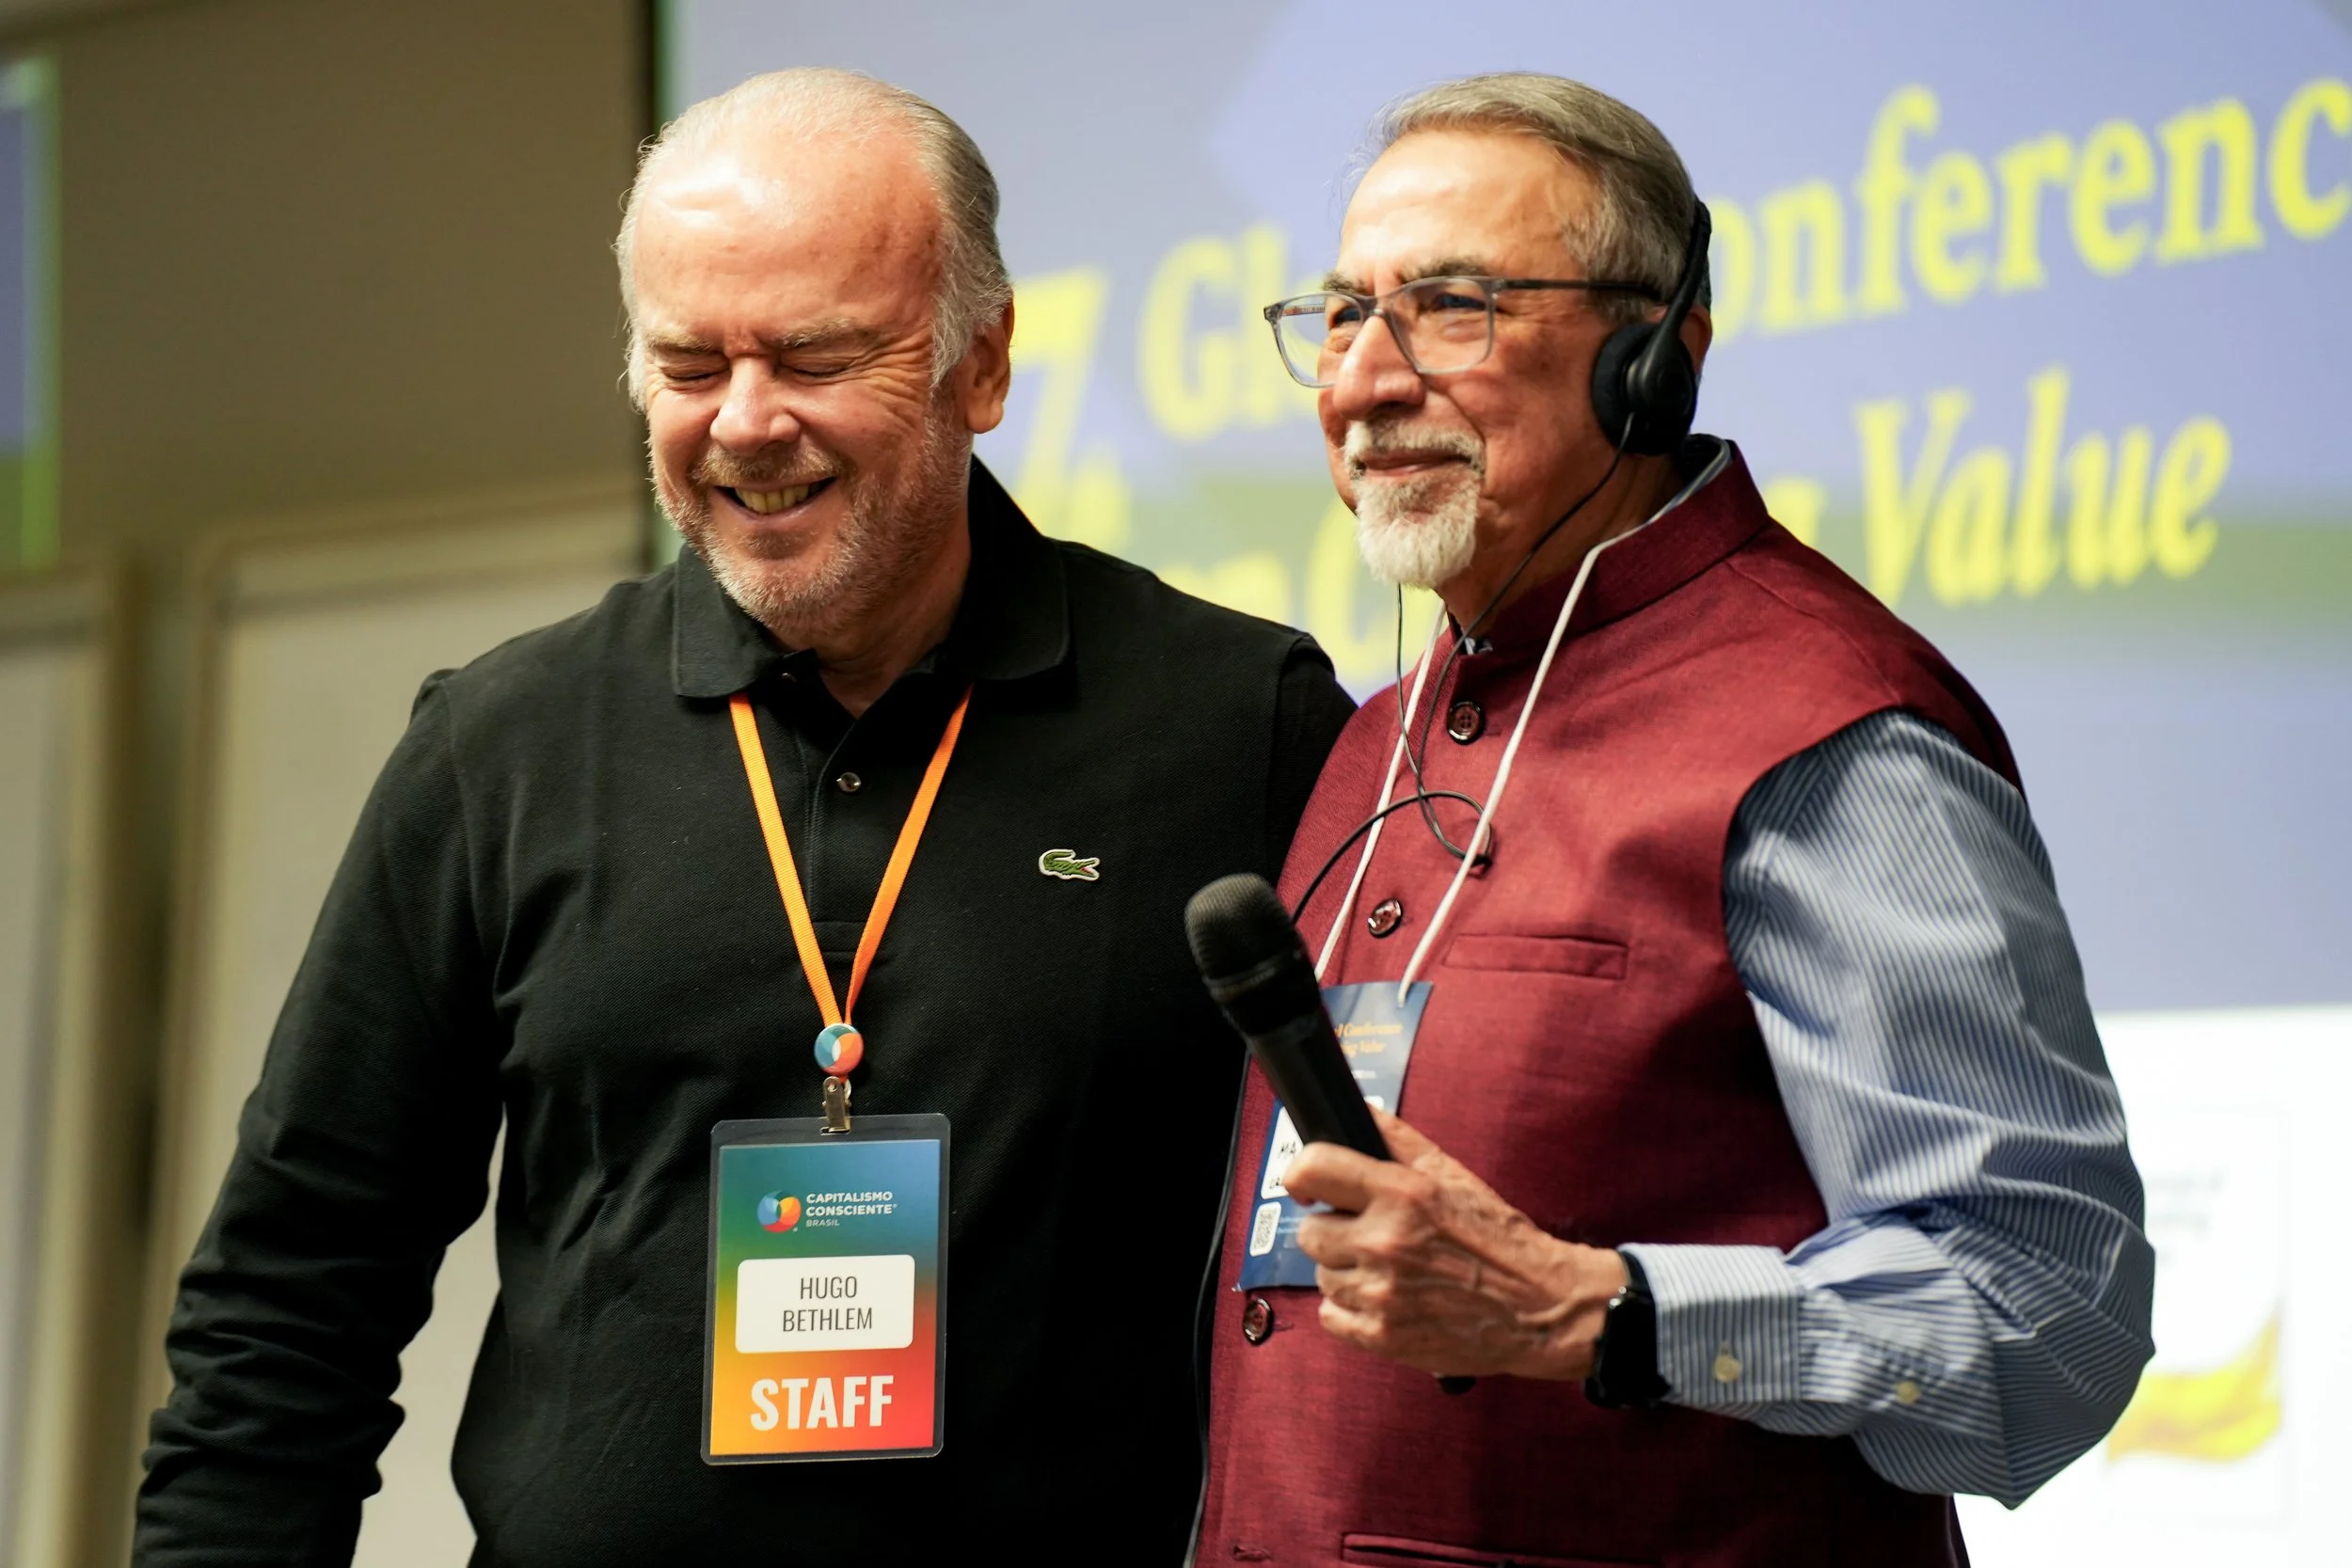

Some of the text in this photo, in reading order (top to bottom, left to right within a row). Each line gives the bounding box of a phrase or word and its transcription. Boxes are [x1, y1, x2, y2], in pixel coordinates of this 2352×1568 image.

[1708, 77, 2352, 348] onferenc
[1853, 365, 2233, 613] Value
[806, 1191, 893, 1204] CAPITALISMO
[805, 1218, 840, 1227] BRASIL
[800, 1275, 858, 1300] HUGO
[783, 1307, 873, 1333] BETHLEM
[750, 1375, 894, 1432] STAFF
